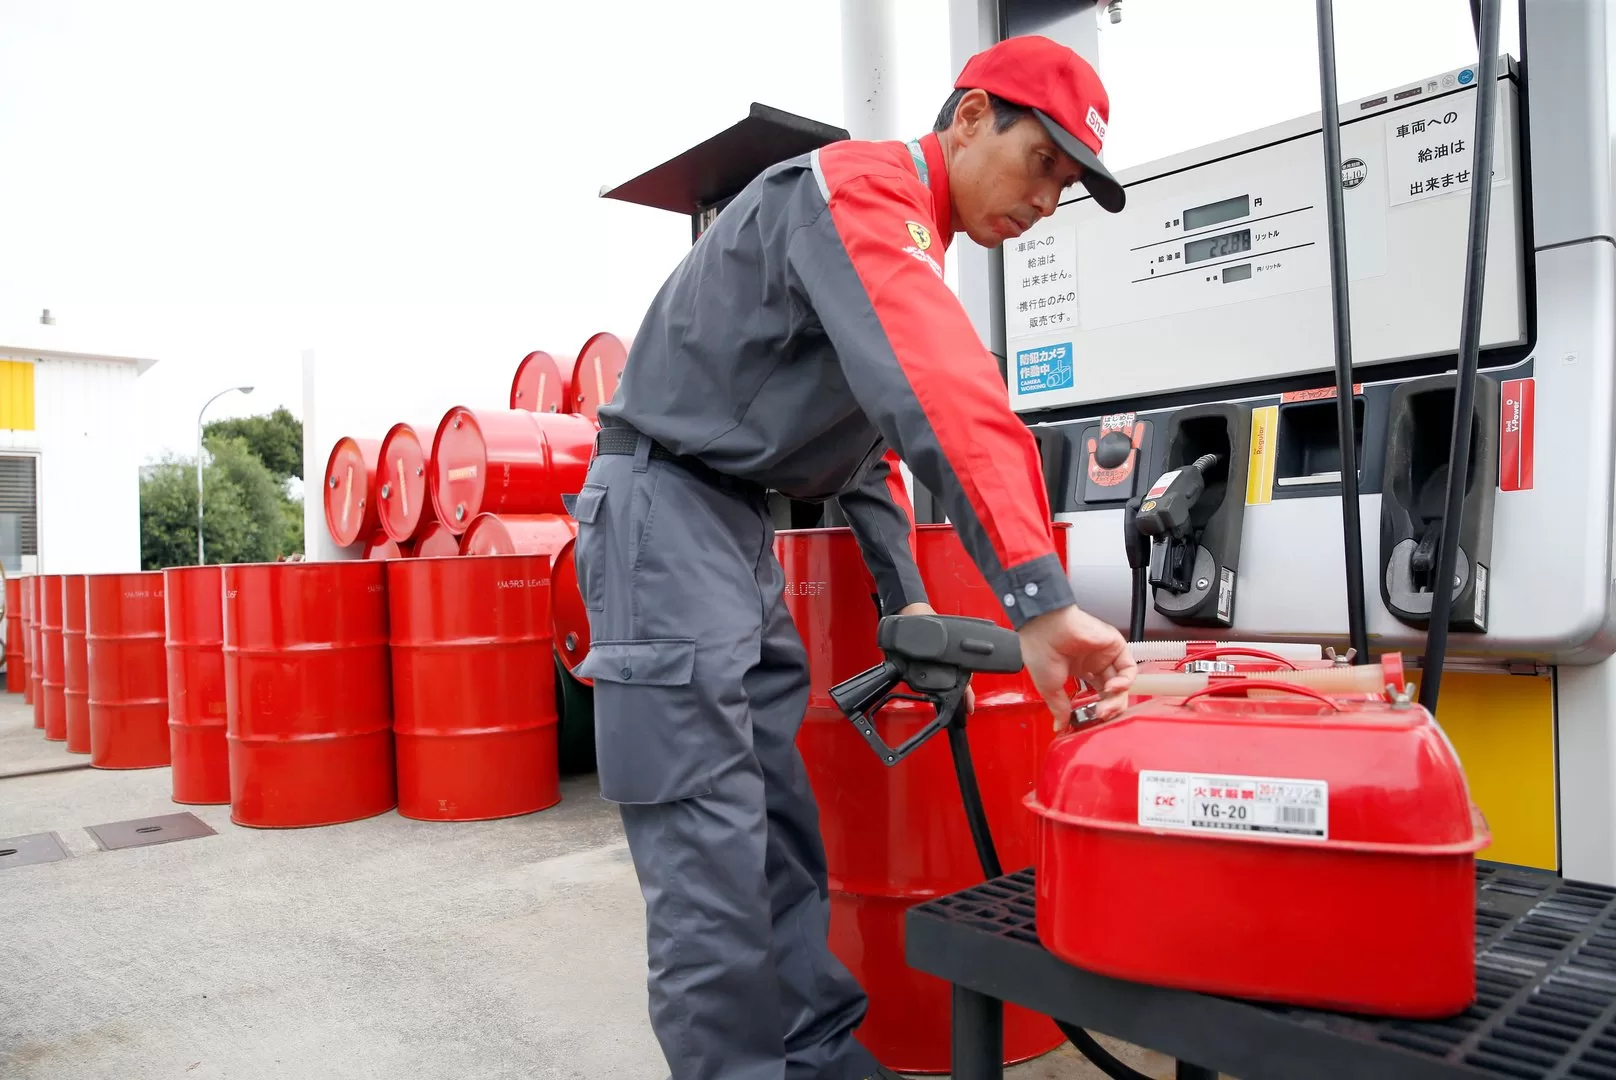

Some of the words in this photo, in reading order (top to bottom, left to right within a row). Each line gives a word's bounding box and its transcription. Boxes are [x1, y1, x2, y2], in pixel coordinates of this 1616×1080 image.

[1396, 111, 1458, 138] 車両への
[1417, 139, 1466, 163] 給油は
[1254, 197, 1263, 207] 円
[1255, 230, 1280, 242] リットル
[1028, 253, 1056, 268] 給油は
[1022, 269, 1073, 288] 出来ません。
[1029, 312, 1071, 328] 販売です。
[1019, 346, 1067, 366] 防犯カメラ
[1020, 363, 1050, 379] 作動中
[1020, 378, 1041, 387] CAMERA
[1020, 383, 1046, 392] WORKING
[1104, 413, 1134, 423] はじめに
[1512, 401, 1520, 433] V-Power
[1256, 426, 1265, 455] Regular
[1194, 787, 1254, 799] 火気厳禁
[1202, 802, 1247, 818] YG-20
